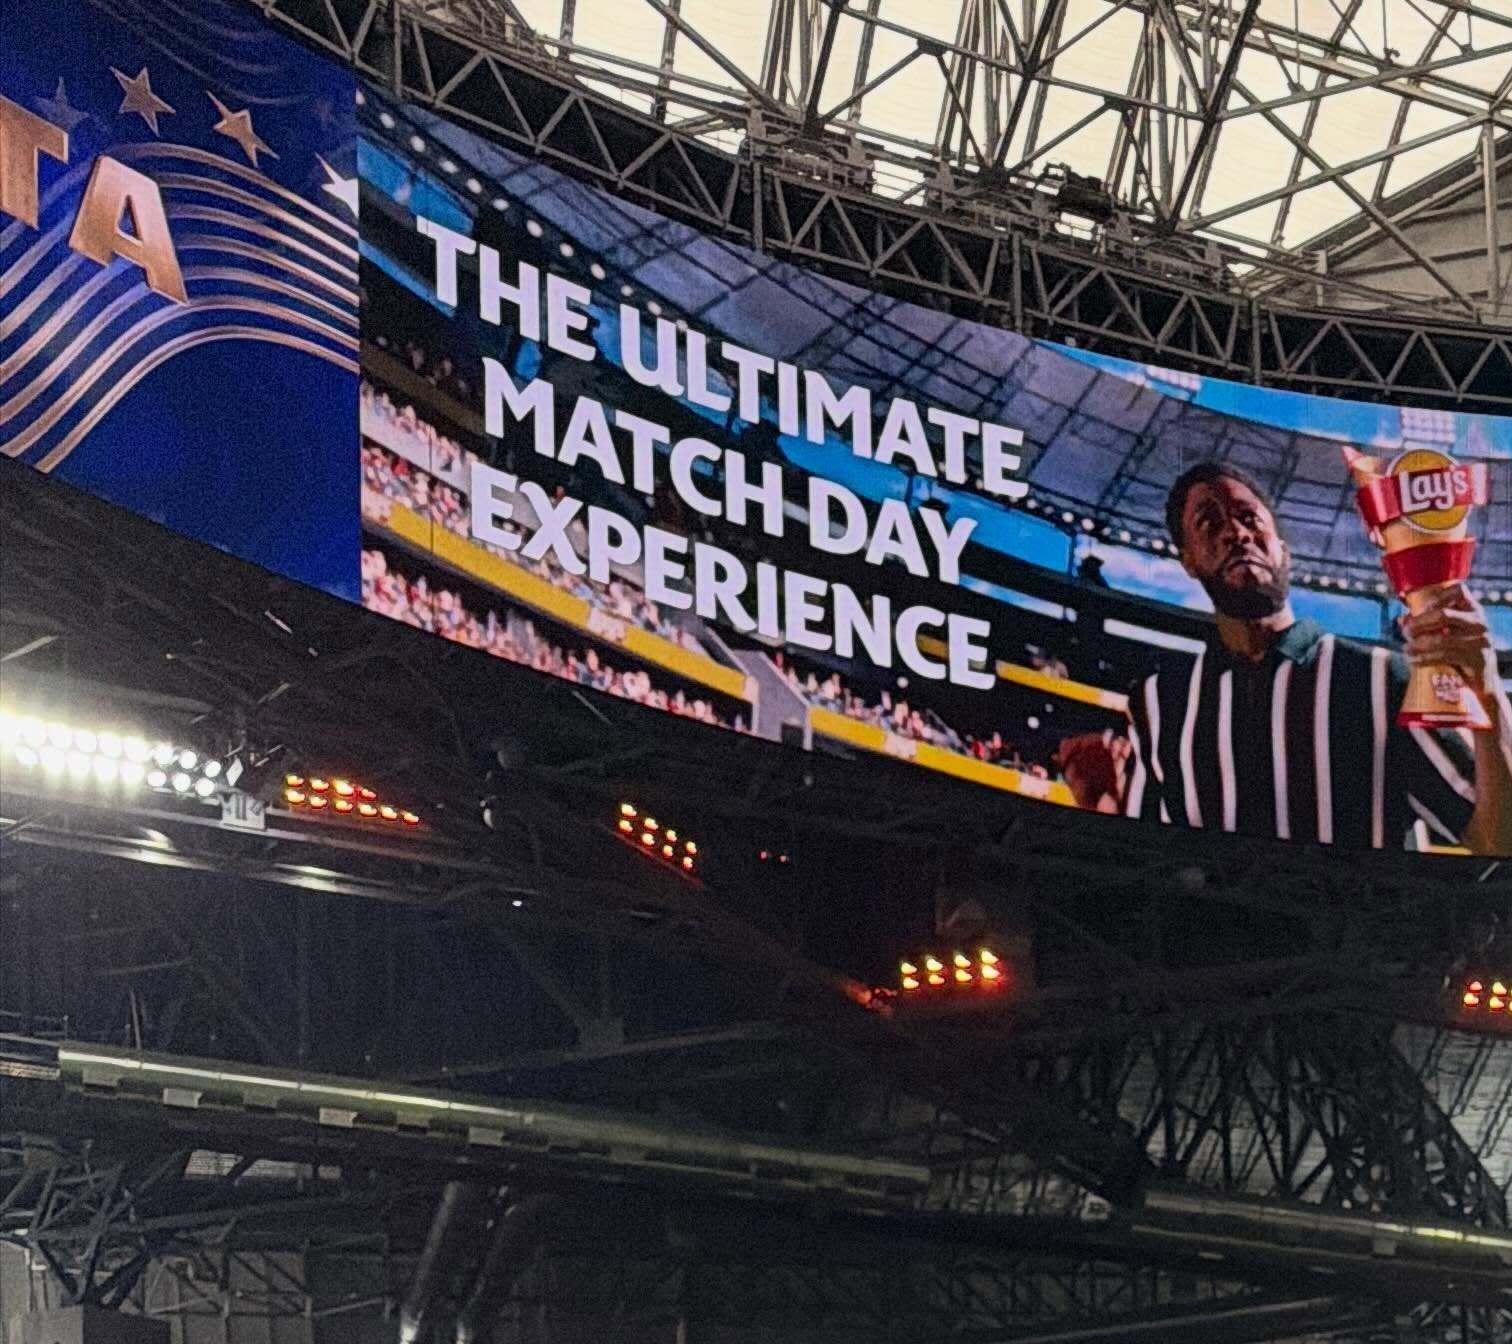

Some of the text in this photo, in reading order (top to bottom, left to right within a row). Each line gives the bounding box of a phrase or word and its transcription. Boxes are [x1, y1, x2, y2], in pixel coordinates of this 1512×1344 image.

[415, 215, 1029, 499] THE ULTIMATE
[482, 356, 979, 584] MATCH DAY
[469, 461, 997, 691] EXPERIENCE
[1399, 465, 1470, 514] Lay's
